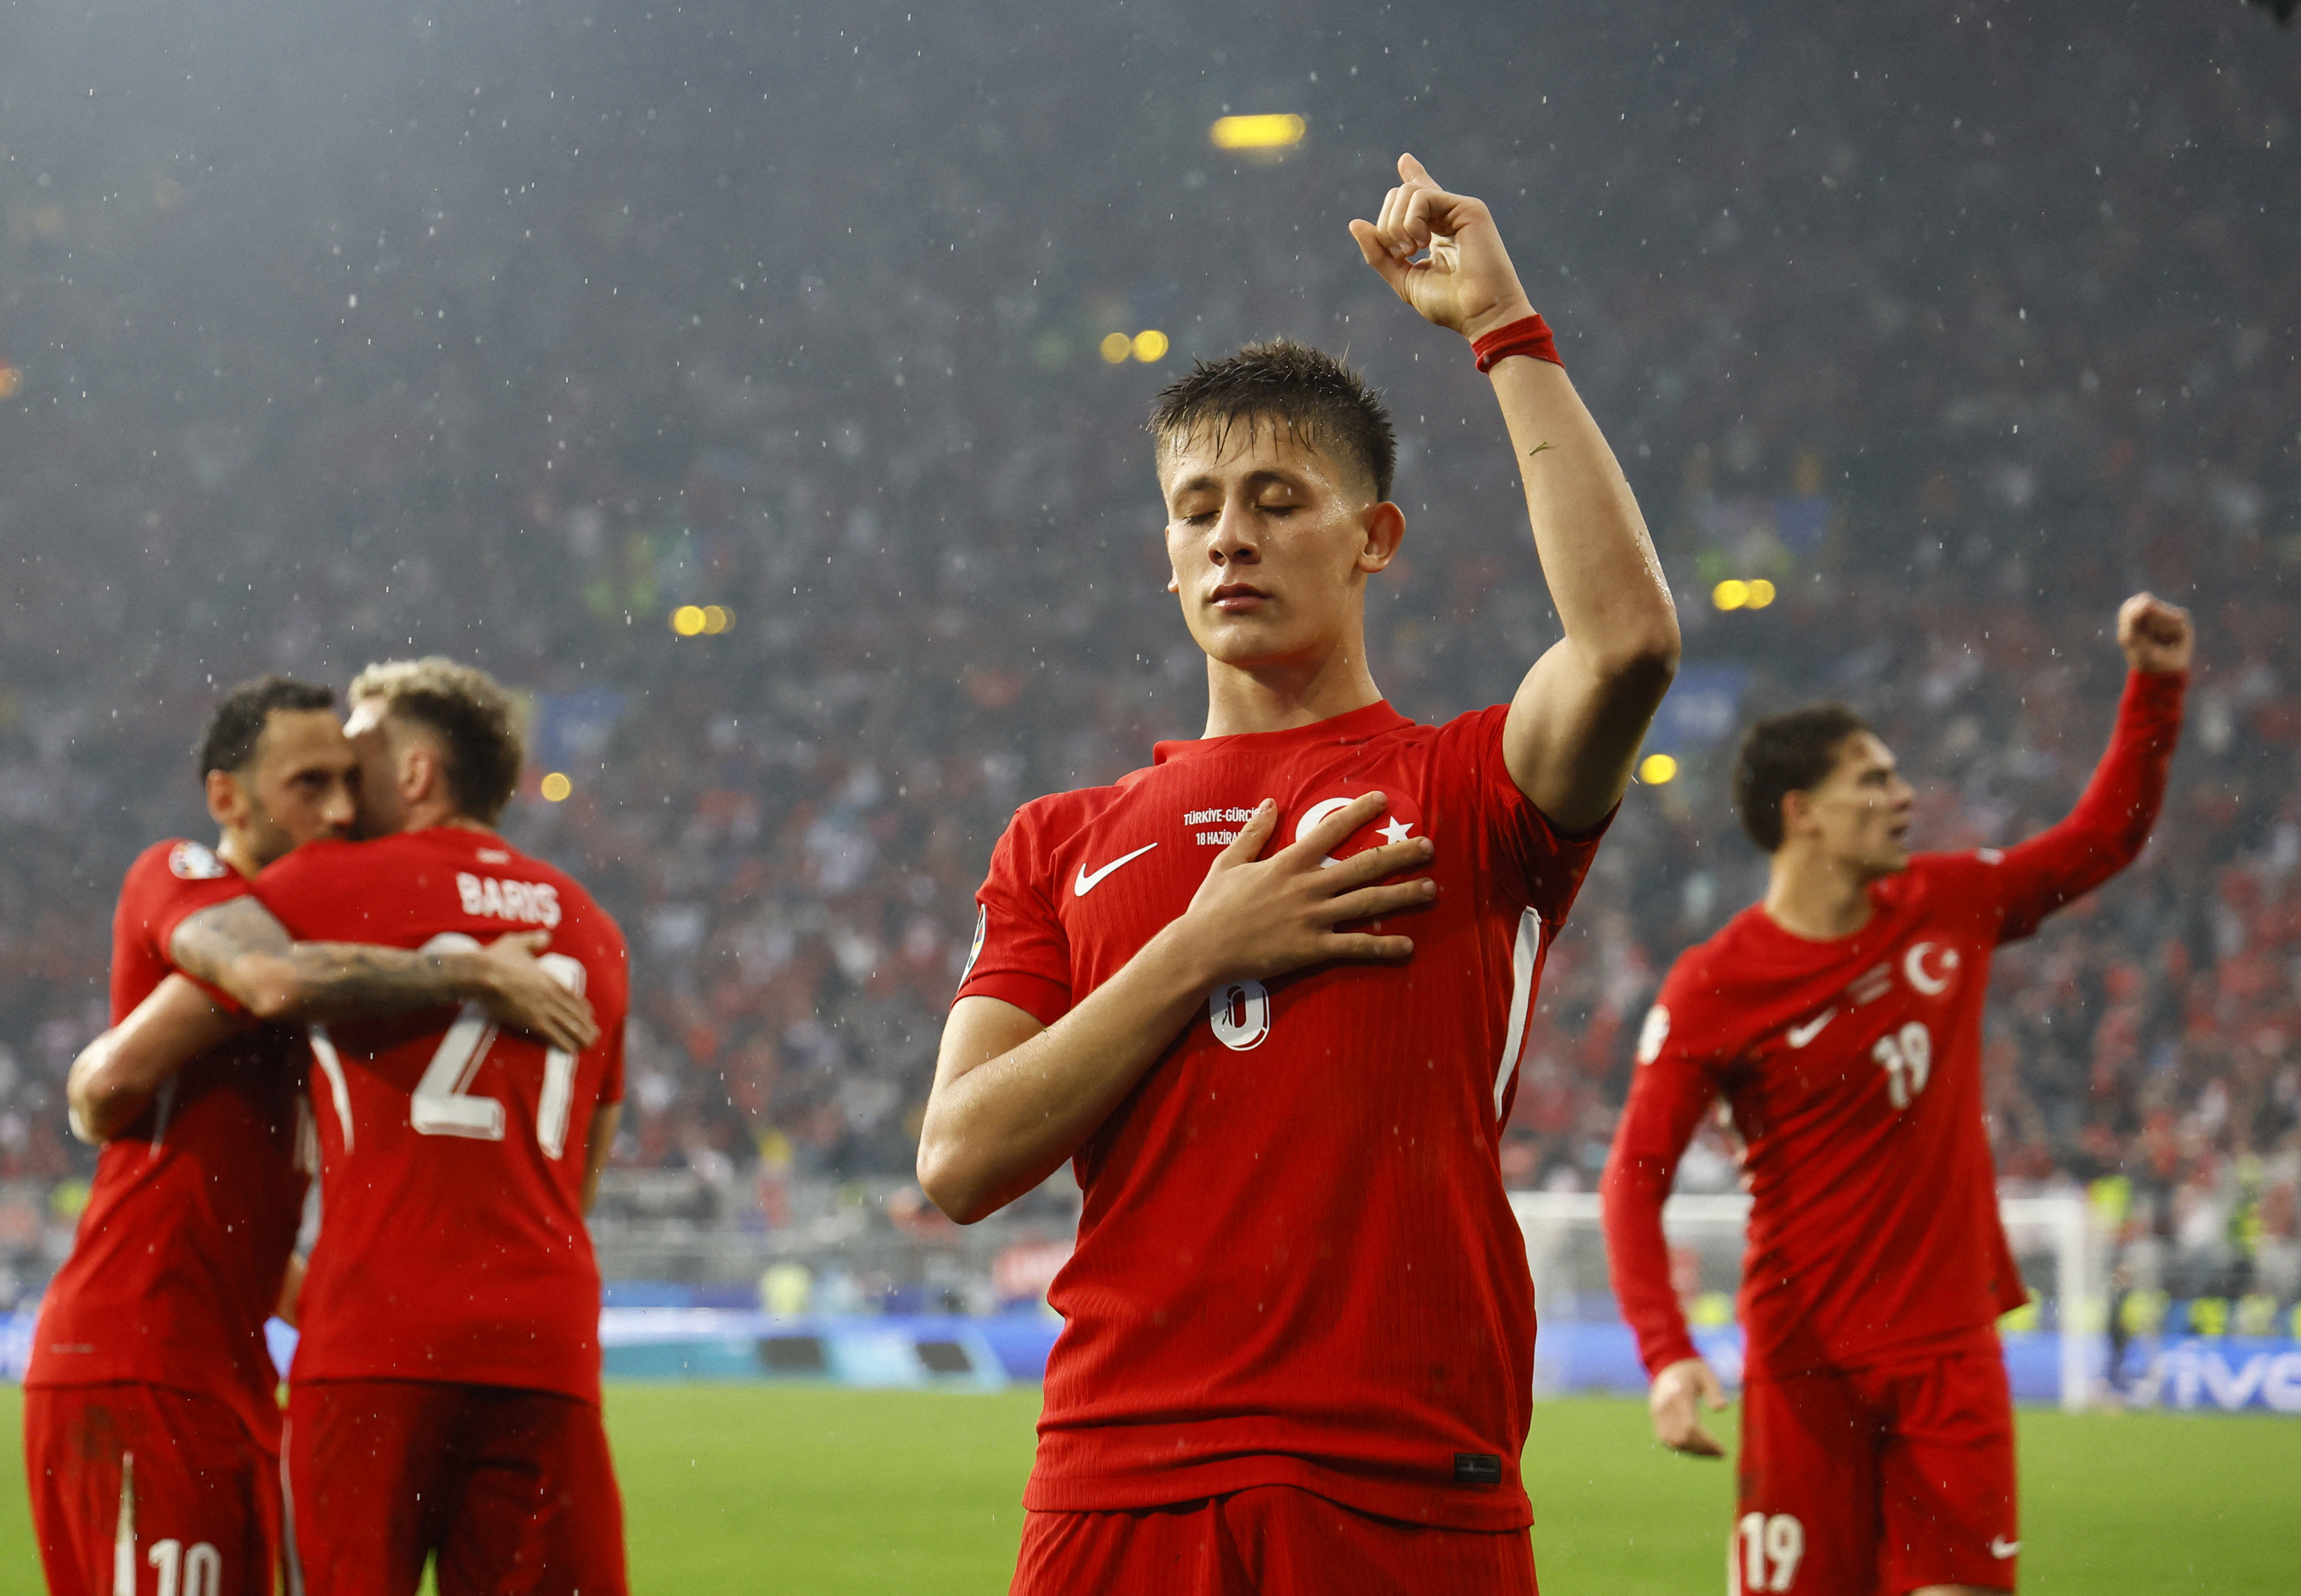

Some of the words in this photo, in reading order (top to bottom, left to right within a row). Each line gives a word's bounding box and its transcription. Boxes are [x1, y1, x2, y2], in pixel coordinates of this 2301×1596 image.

[1196, 832, 1206, 846] 18
[1207, 829, 1241, 845] HAZİRA
[1871, 1021, 1931, 1110] 19
[148, 1537, 223, 1596] 10
[1737, 1511, 1806, 1594] 19
